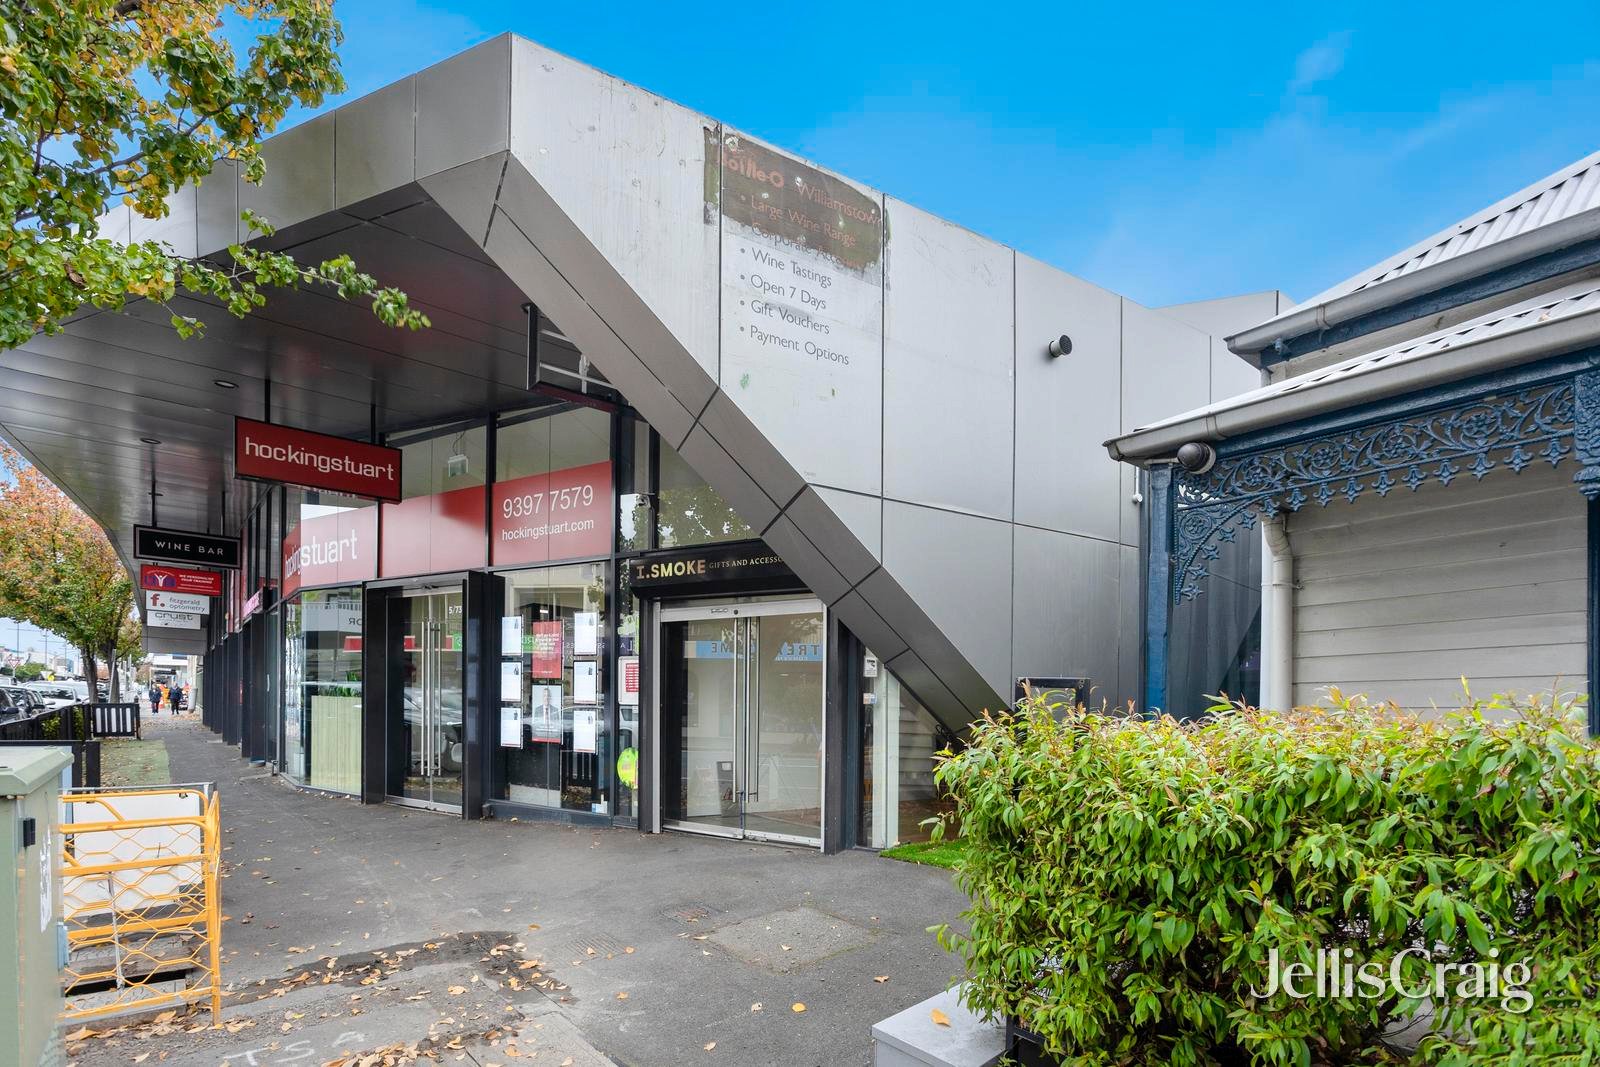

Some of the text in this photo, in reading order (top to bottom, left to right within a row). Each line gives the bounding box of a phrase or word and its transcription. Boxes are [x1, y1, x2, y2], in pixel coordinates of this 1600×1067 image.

[751, 195, 856, 247] Large Wine Range
[752, 247, 832, 288] Wine Tastings
[750, 274, 826, 310] Open 7 Days
[751, 299, 830, 334] Gift Vouchers
[750, 325, 849, 365] Payment Options
[245, 436, 394, 481] hockingstuart
[502, 484, 594, 520] 9397 7579
[502, 517, 594, 541] hockingstuart.com
[155, 540, 224, 555] WINE BAR
[636, 559, 706, 580] I.SMOKE
[709, 561, 730, 569] GIFTS
[732, 559, 748, 567] AND
[155, 612, 193, 621] crust
[169, 603, 205, 612] optometry
